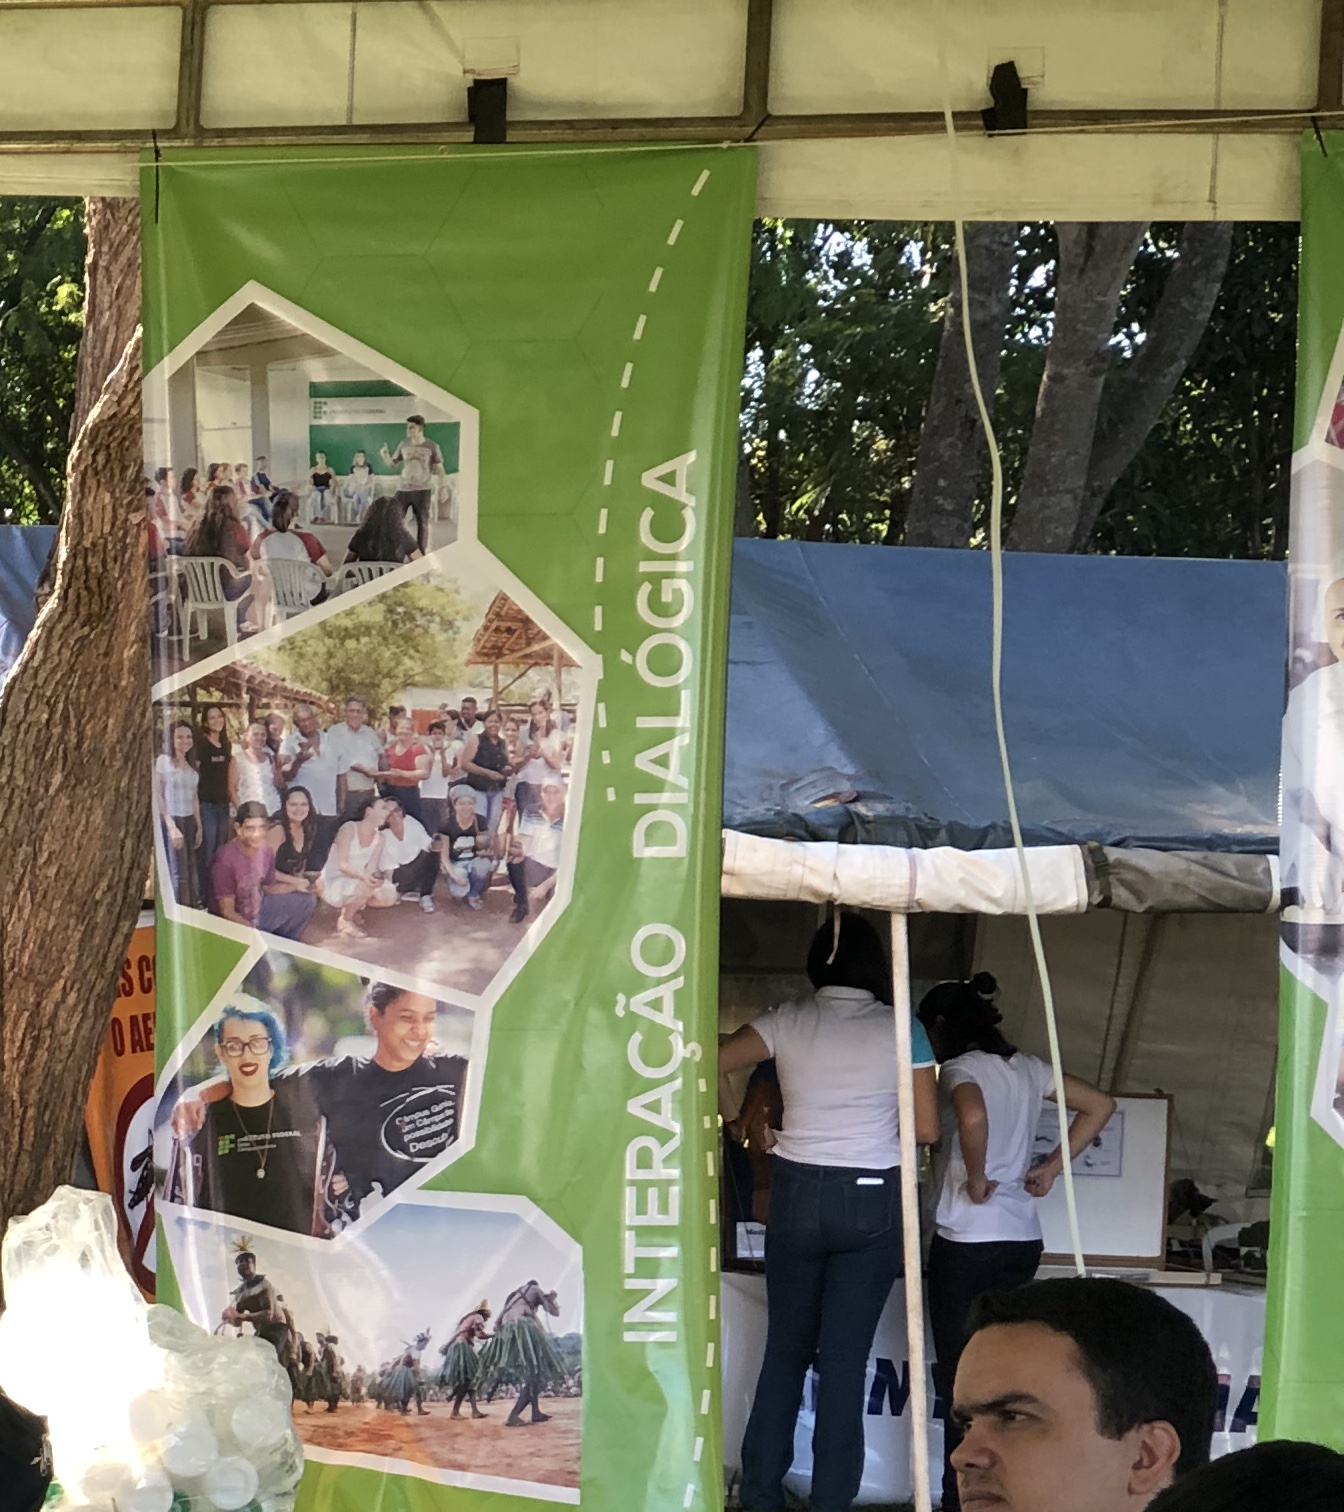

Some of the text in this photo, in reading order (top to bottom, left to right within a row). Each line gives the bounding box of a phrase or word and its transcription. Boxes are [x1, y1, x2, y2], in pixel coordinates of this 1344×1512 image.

[615, 449, 703, 1343] INTERAÇÃO DIALÓGICA
[138, 954, 156, 995] C
[129, 1011, 156, 1054] AE
